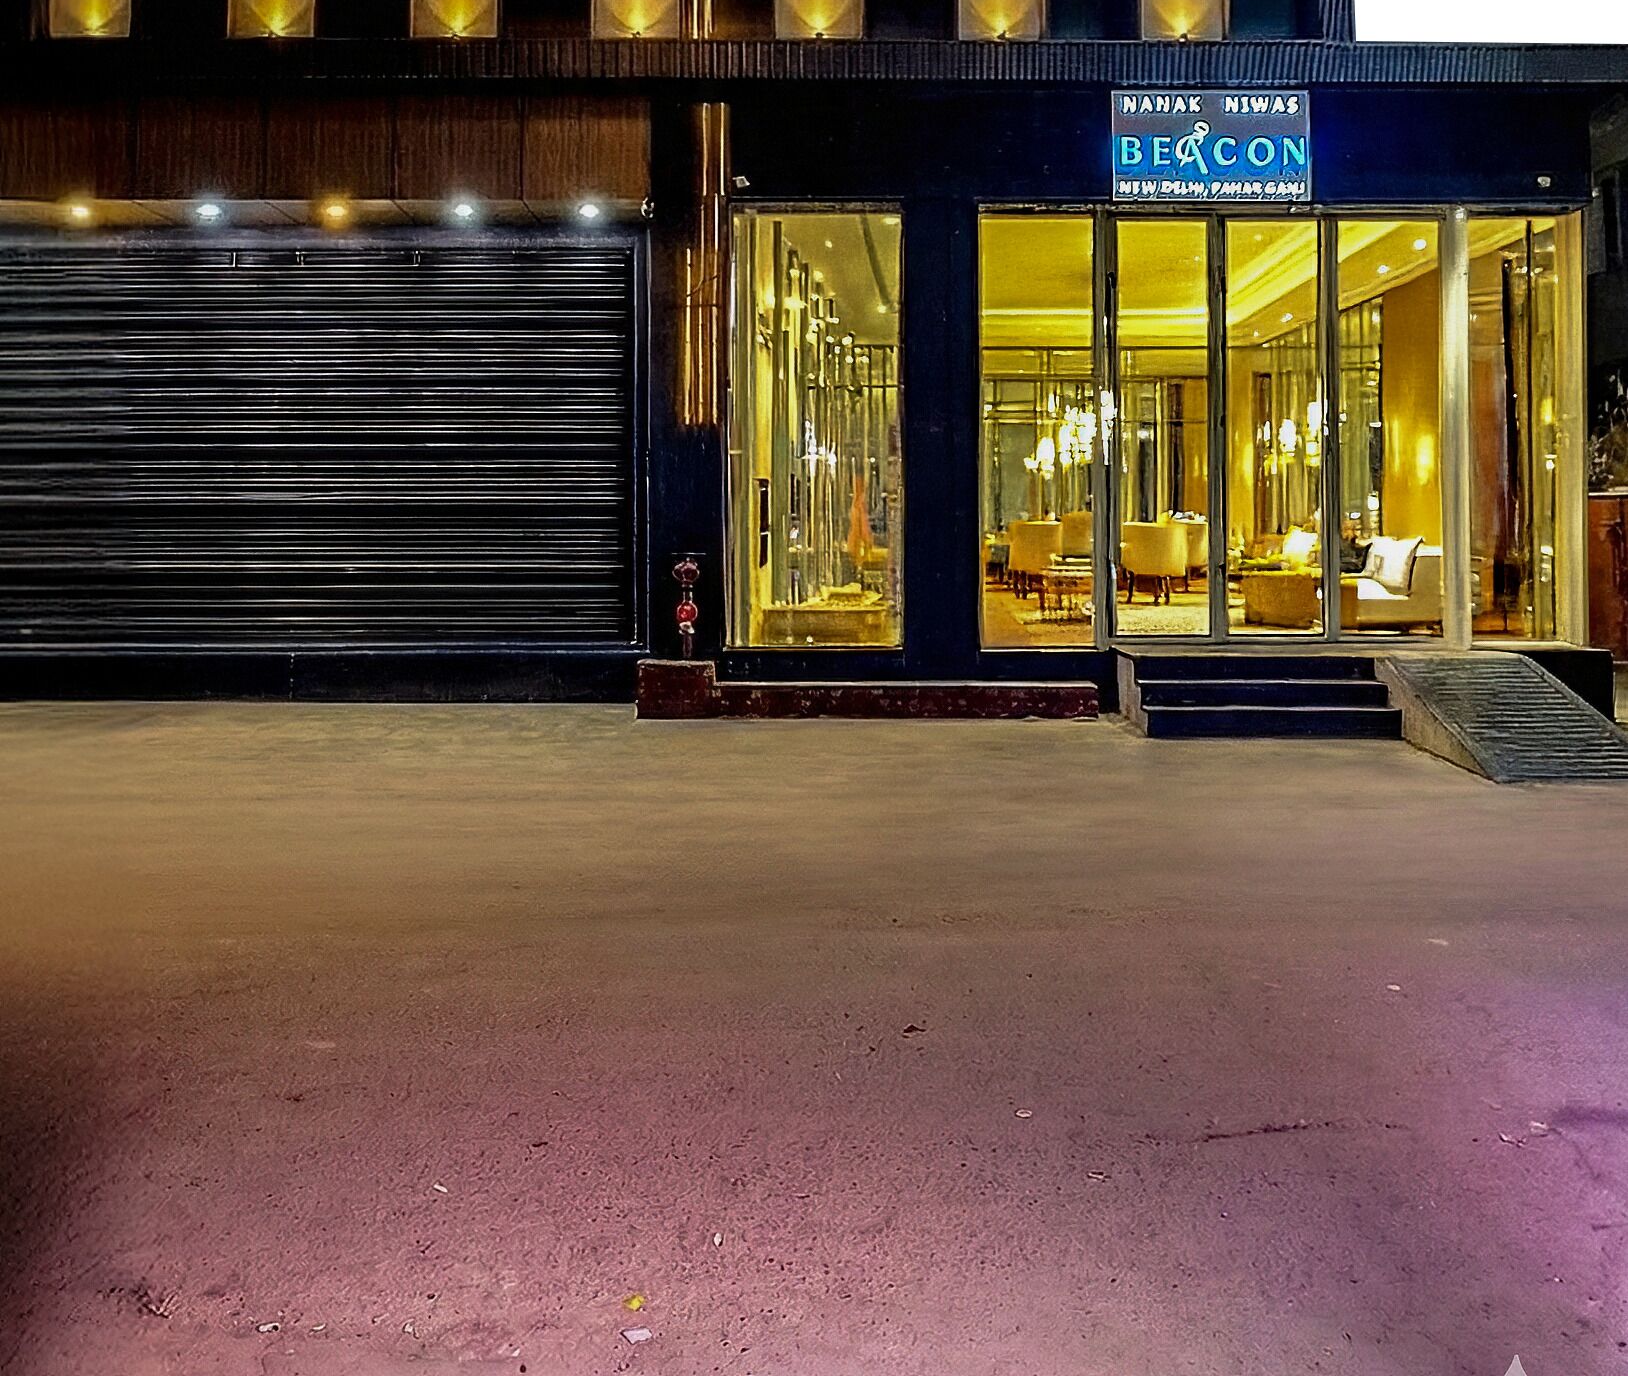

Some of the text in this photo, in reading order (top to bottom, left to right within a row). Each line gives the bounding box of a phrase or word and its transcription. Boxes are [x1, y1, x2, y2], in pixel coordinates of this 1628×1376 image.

[1122, 95, 1300, 114] NANAK NIWAS
[1120, 133, 1305, 174] BEACON
[1118, 180, 1157, 195] NEW
